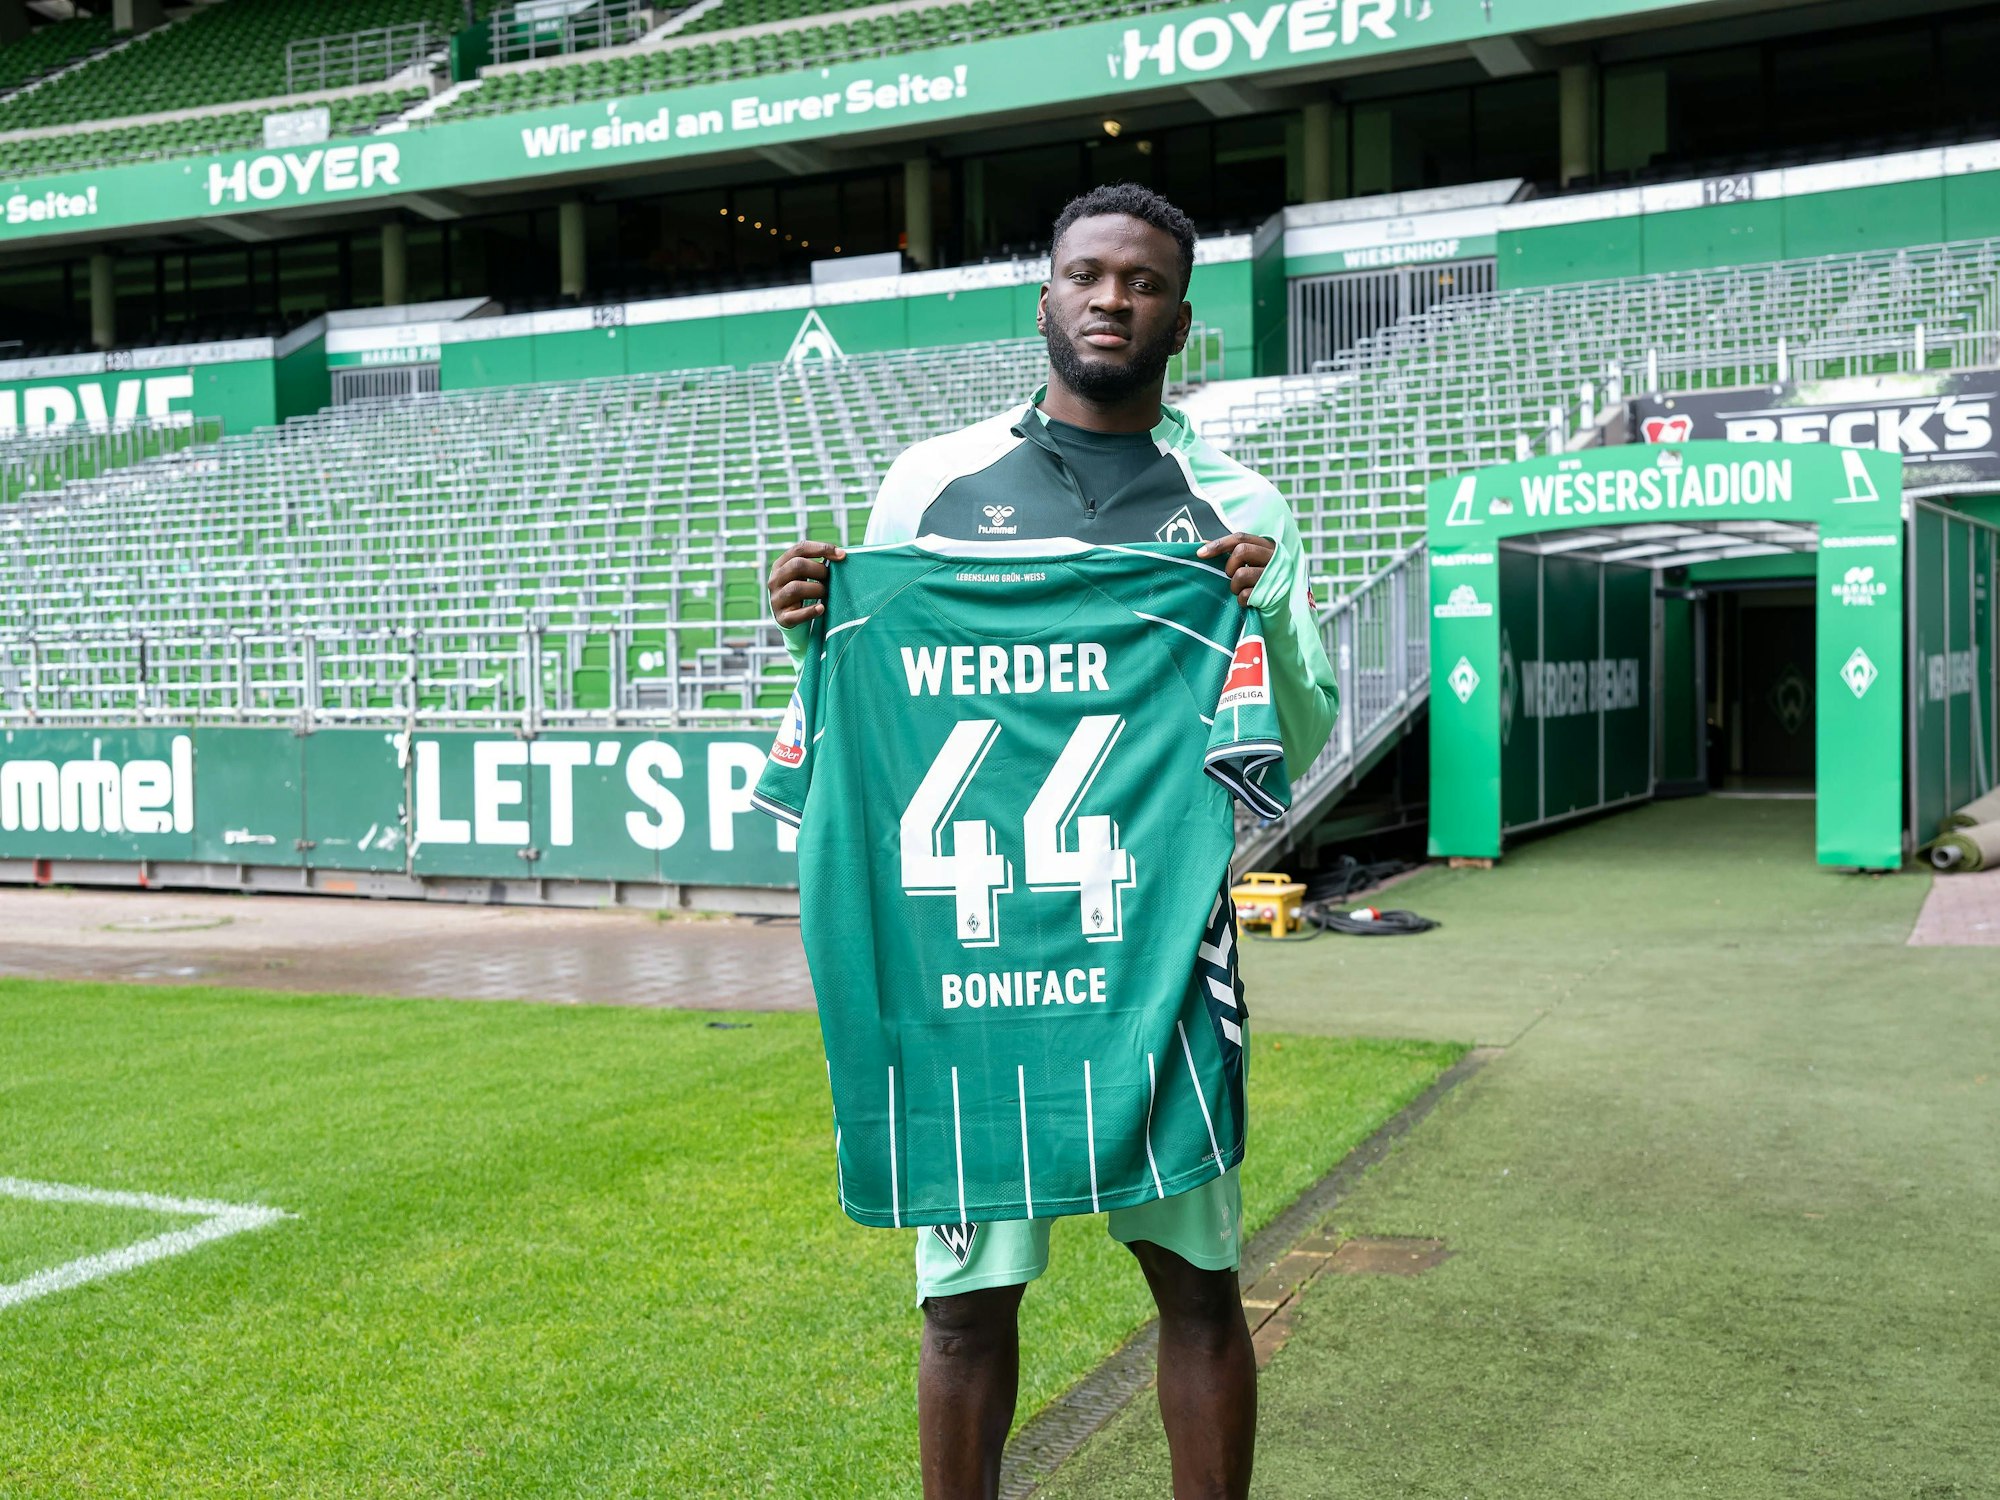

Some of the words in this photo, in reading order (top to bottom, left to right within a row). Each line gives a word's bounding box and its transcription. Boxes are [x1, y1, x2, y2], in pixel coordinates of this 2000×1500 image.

[1123, 0, 1397, 80] HOYER
[520, 122, 588, 158] Wir
[591, 106, 669, 150] sind
[675, 109, 723, 138] an
[731, 94, 841, 131] Eurer
[845, 65, 969, 114] Seite!
[208, 142, 400, 206] HOYER
[1705, 177, 1751, 204] 124
[6, 185, 98, 224] Seite!
[1343, 239, 1460, 268] WIESENHOF
[1520, 458, 1793, 518] WESERSTADION
[978, 524, 1018, 535] hummel
[956, 573, 1000, 583] LEBENSLANG
[1001, 572, 1046, 583] GRÜN-WEISS
[901, 642, 1110, 697] WERDER
[415, 740, 686, 852] LET'S
[900, 714, 1137, 949] 44
[942, 967, 1107, 1010] BONIFACE
